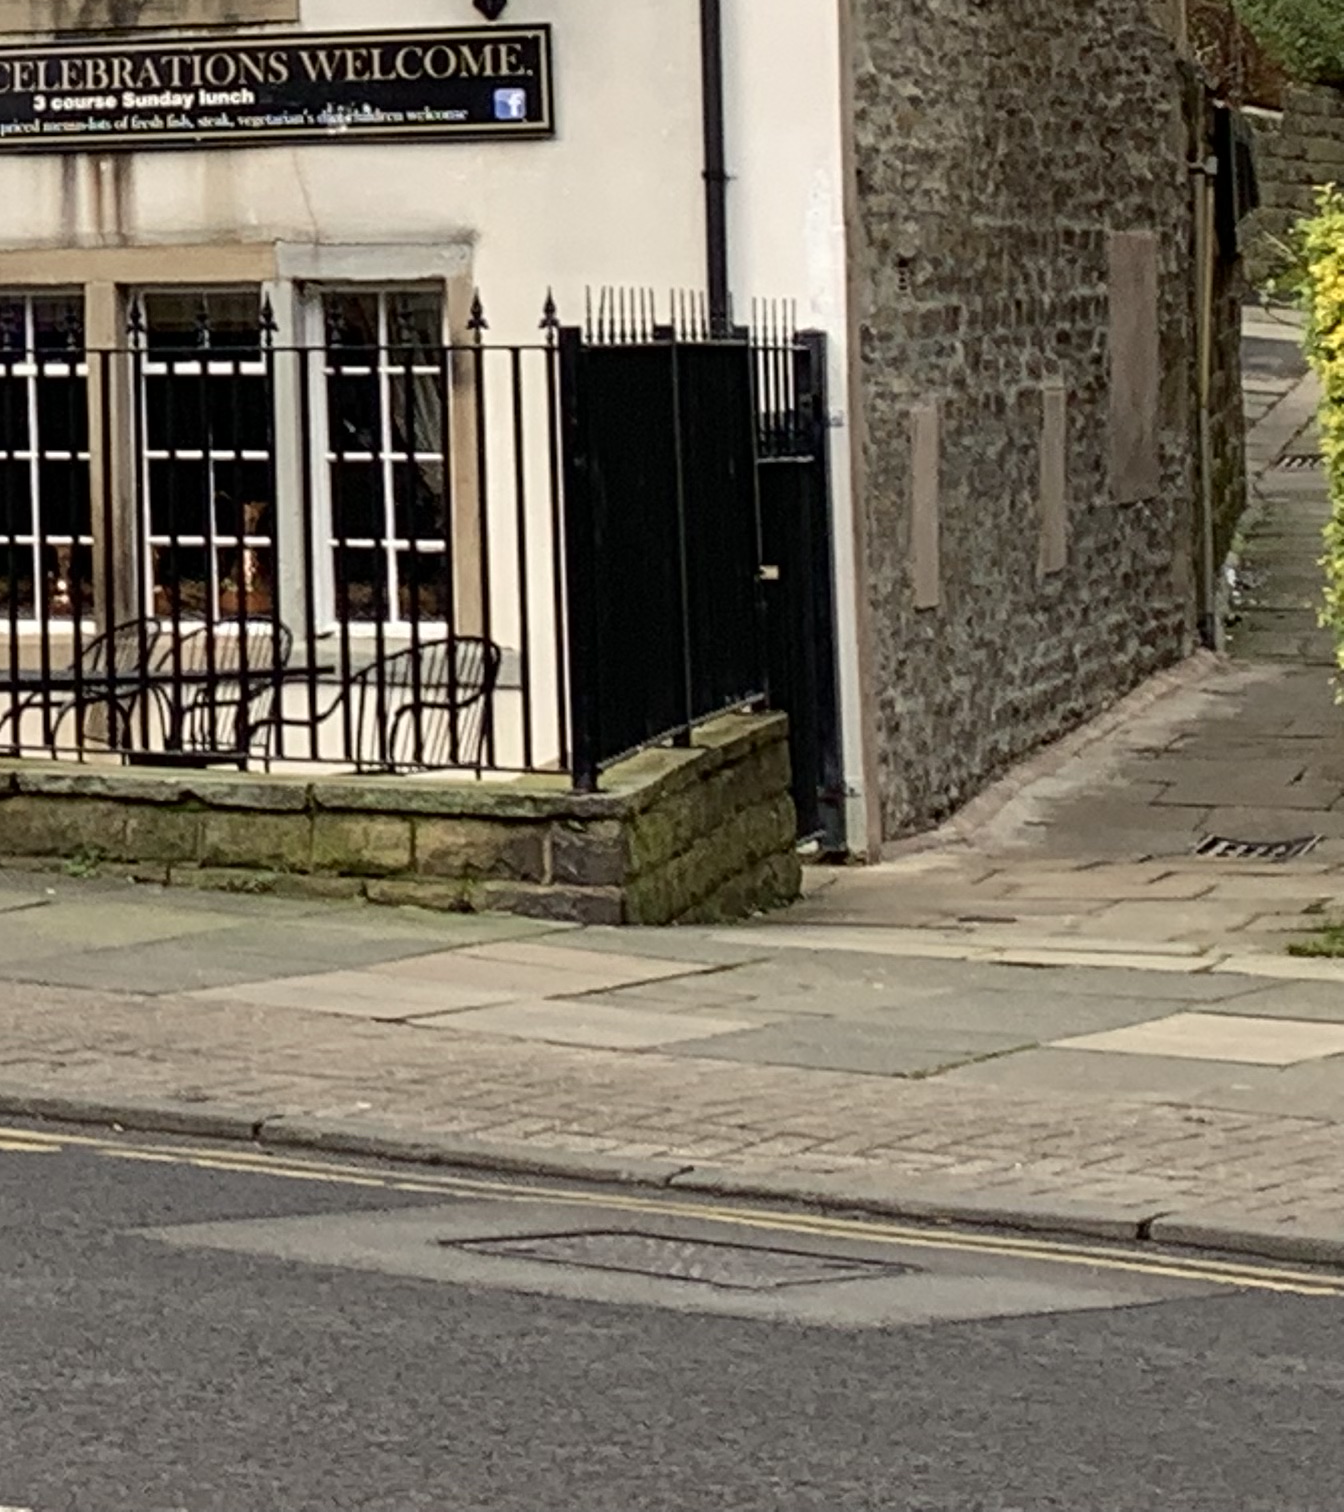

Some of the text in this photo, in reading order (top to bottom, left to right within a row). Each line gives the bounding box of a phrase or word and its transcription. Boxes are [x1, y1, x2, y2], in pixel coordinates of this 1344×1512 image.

[299, 44, 534, 82] WELCOME.
[32, 88, 256, 112] 3 course Sunday lunch
